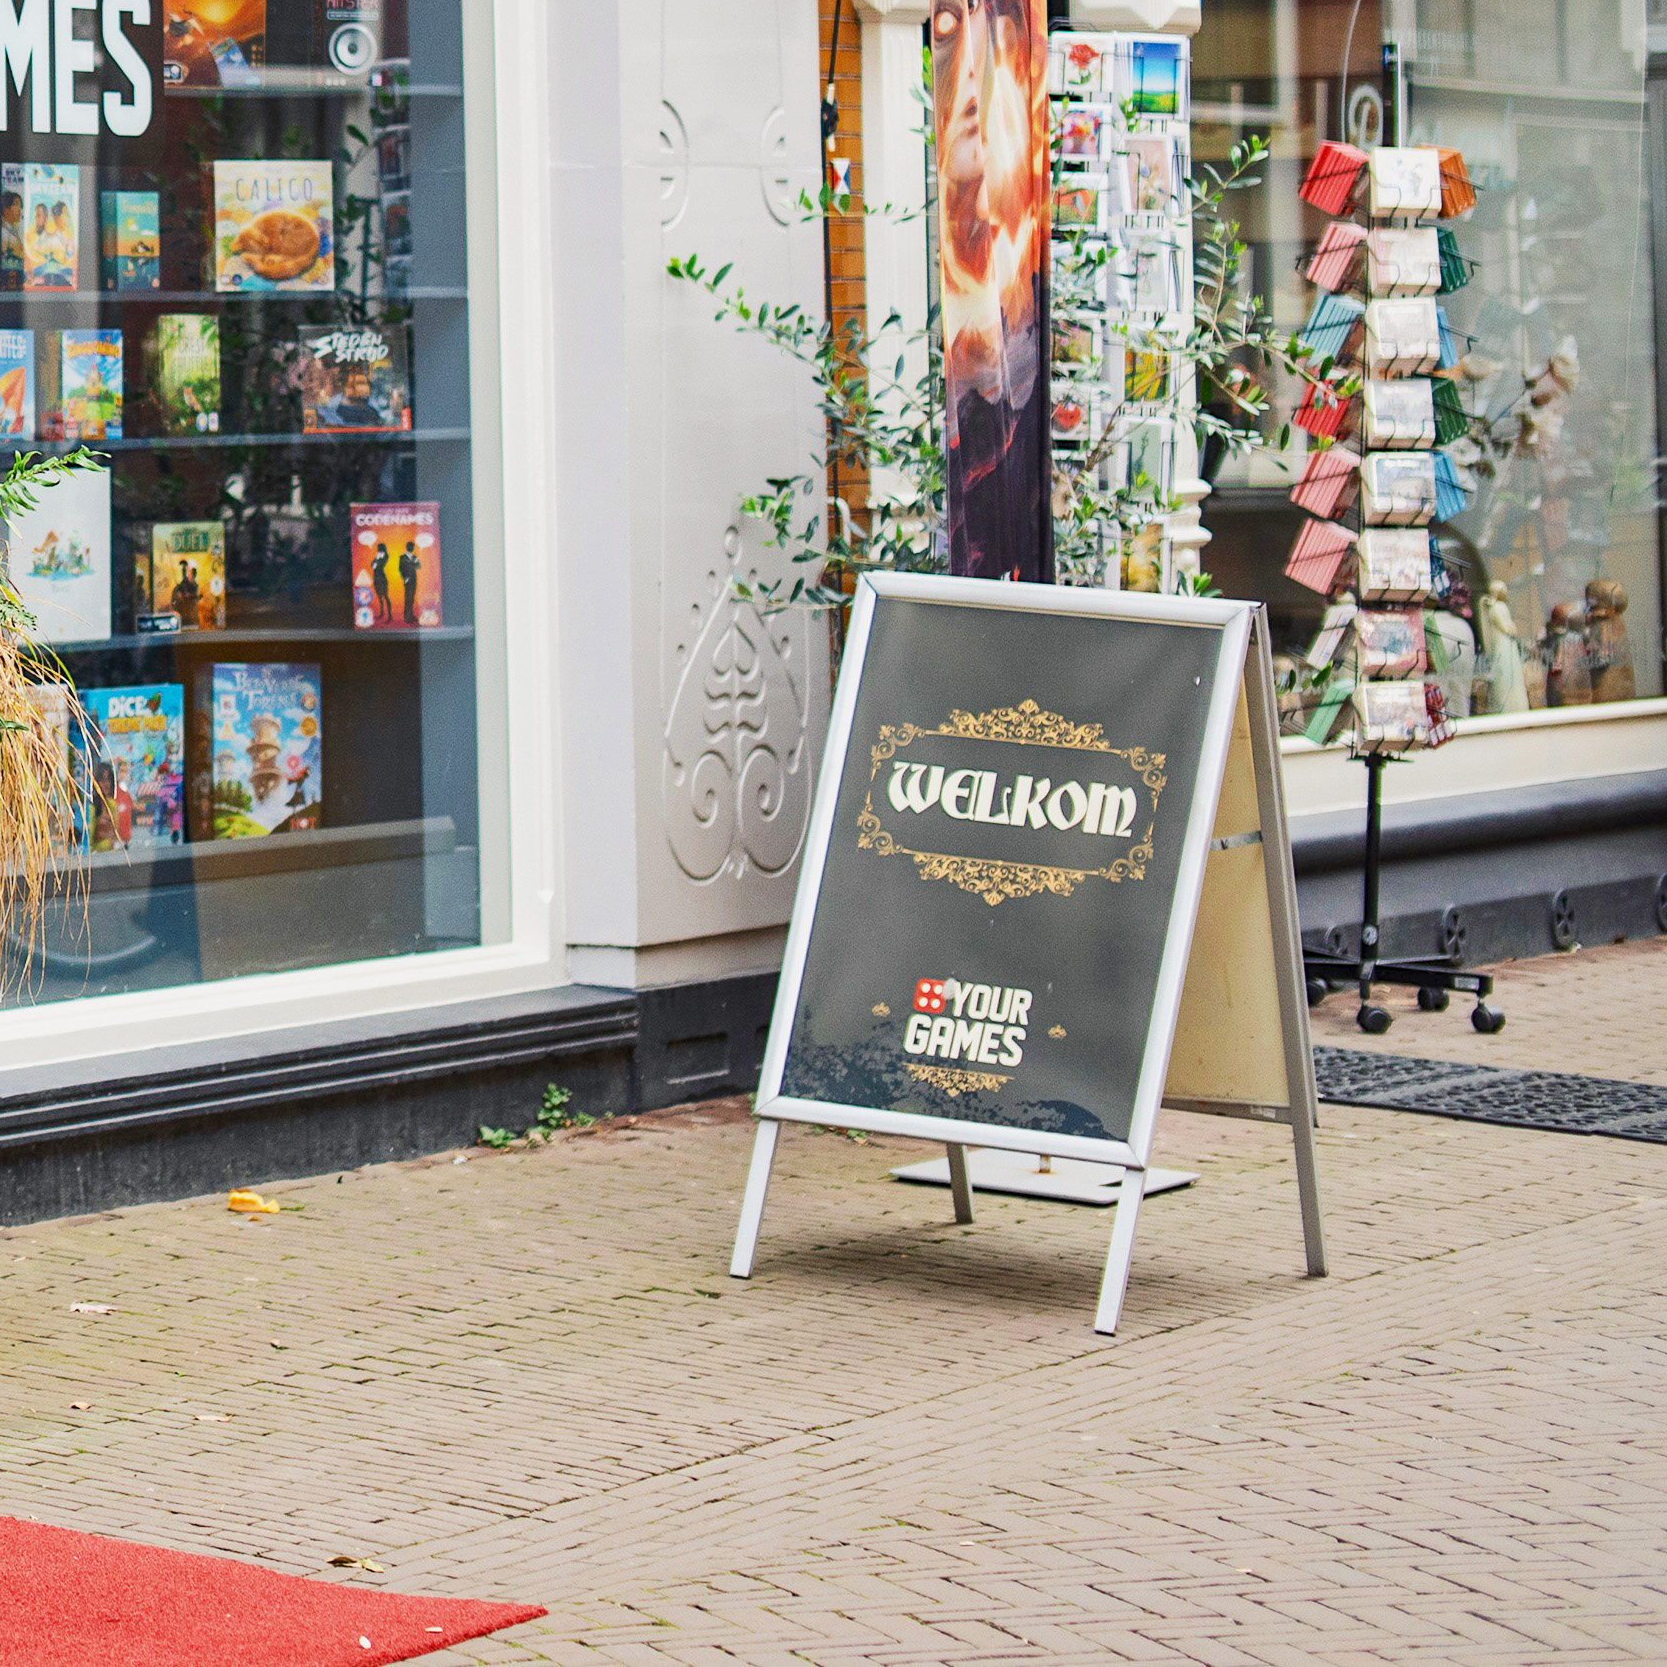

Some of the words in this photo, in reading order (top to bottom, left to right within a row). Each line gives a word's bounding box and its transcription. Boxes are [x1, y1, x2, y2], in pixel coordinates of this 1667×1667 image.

[236, 179, 313, 202] CALICO
[307, 331, 382, 358] STEDEN
[355, 512, 434, 527] CODENAMES
[887, 760, 1138, 839] WELKOM
[950, 979, 1033, 1026] YOUR
[904, 1014, 1027, 1068] GAMES
